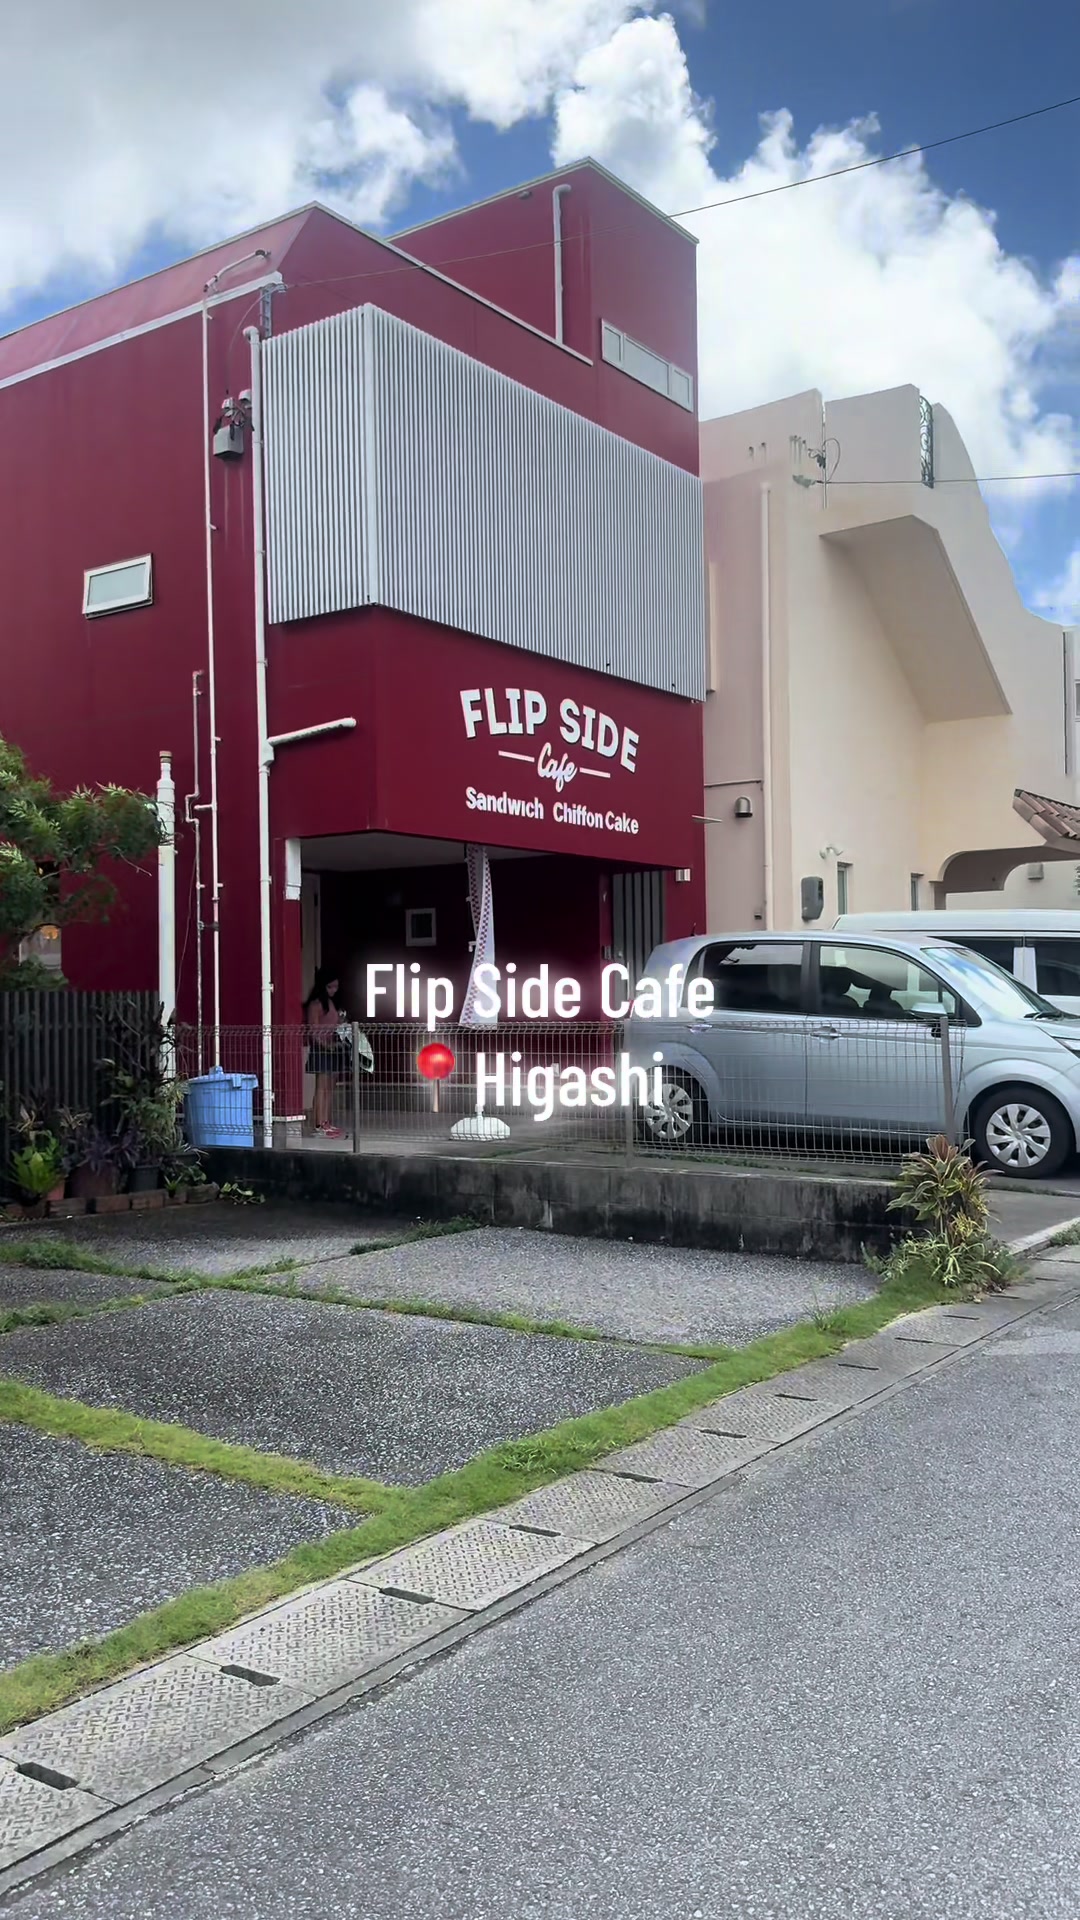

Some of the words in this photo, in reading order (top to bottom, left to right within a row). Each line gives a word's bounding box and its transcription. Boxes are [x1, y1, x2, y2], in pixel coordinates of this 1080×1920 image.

[460, 687, 548, 739] FLIP
[559, 698, 640, 773] SIDE
[537, 742, 578, 793] Cafe
[465, 786, 544, 819] Sandwich
[552, 801, 604, 829] Chiffon
[605, 811, 639, 834] Cake
